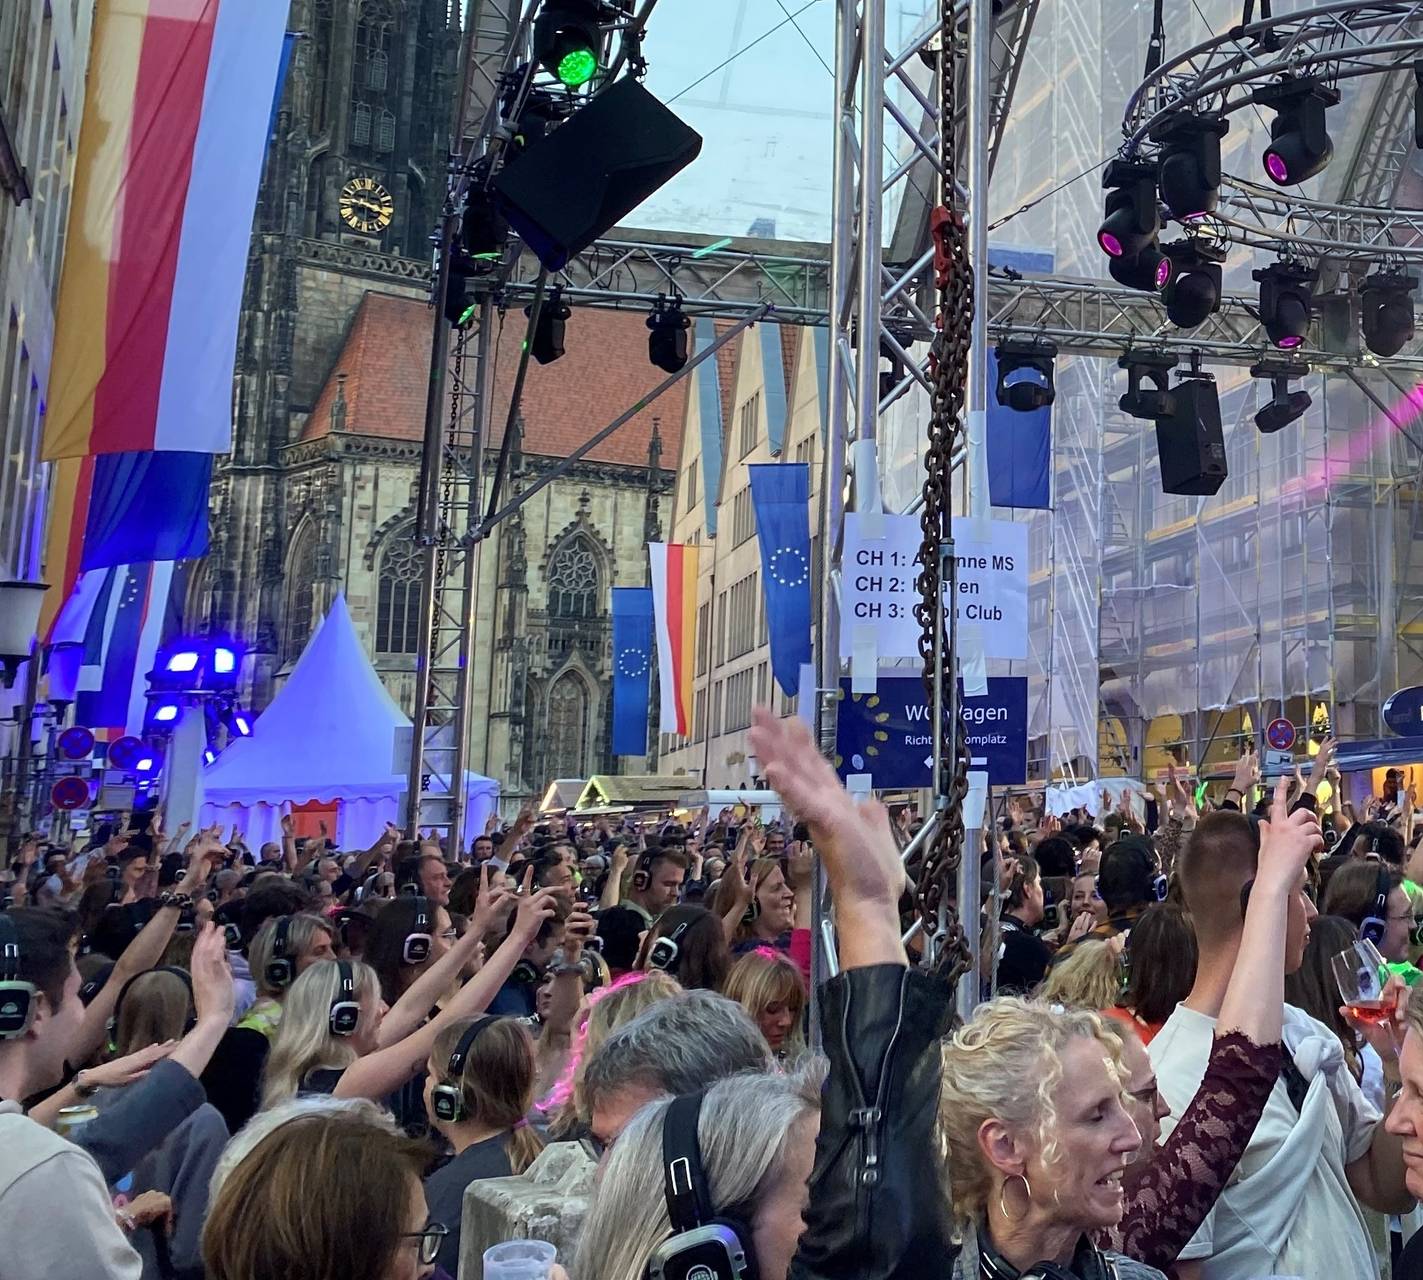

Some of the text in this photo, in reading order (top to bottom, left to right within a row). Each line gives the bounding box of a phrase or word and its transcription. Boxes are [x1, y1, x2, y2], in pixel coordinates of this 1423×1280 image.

[856, 551, 1014, 571] CH 1: Anne MS
[855, 577, 882, 592] CH
[888, 578, 905, 592] 2:
[854, 603, 881, 618] CH
[888, 604, 904, 618] 3:
[966, 605, 1002, 621] Club
[905, 733, 1006, 746] Richt omplatz
